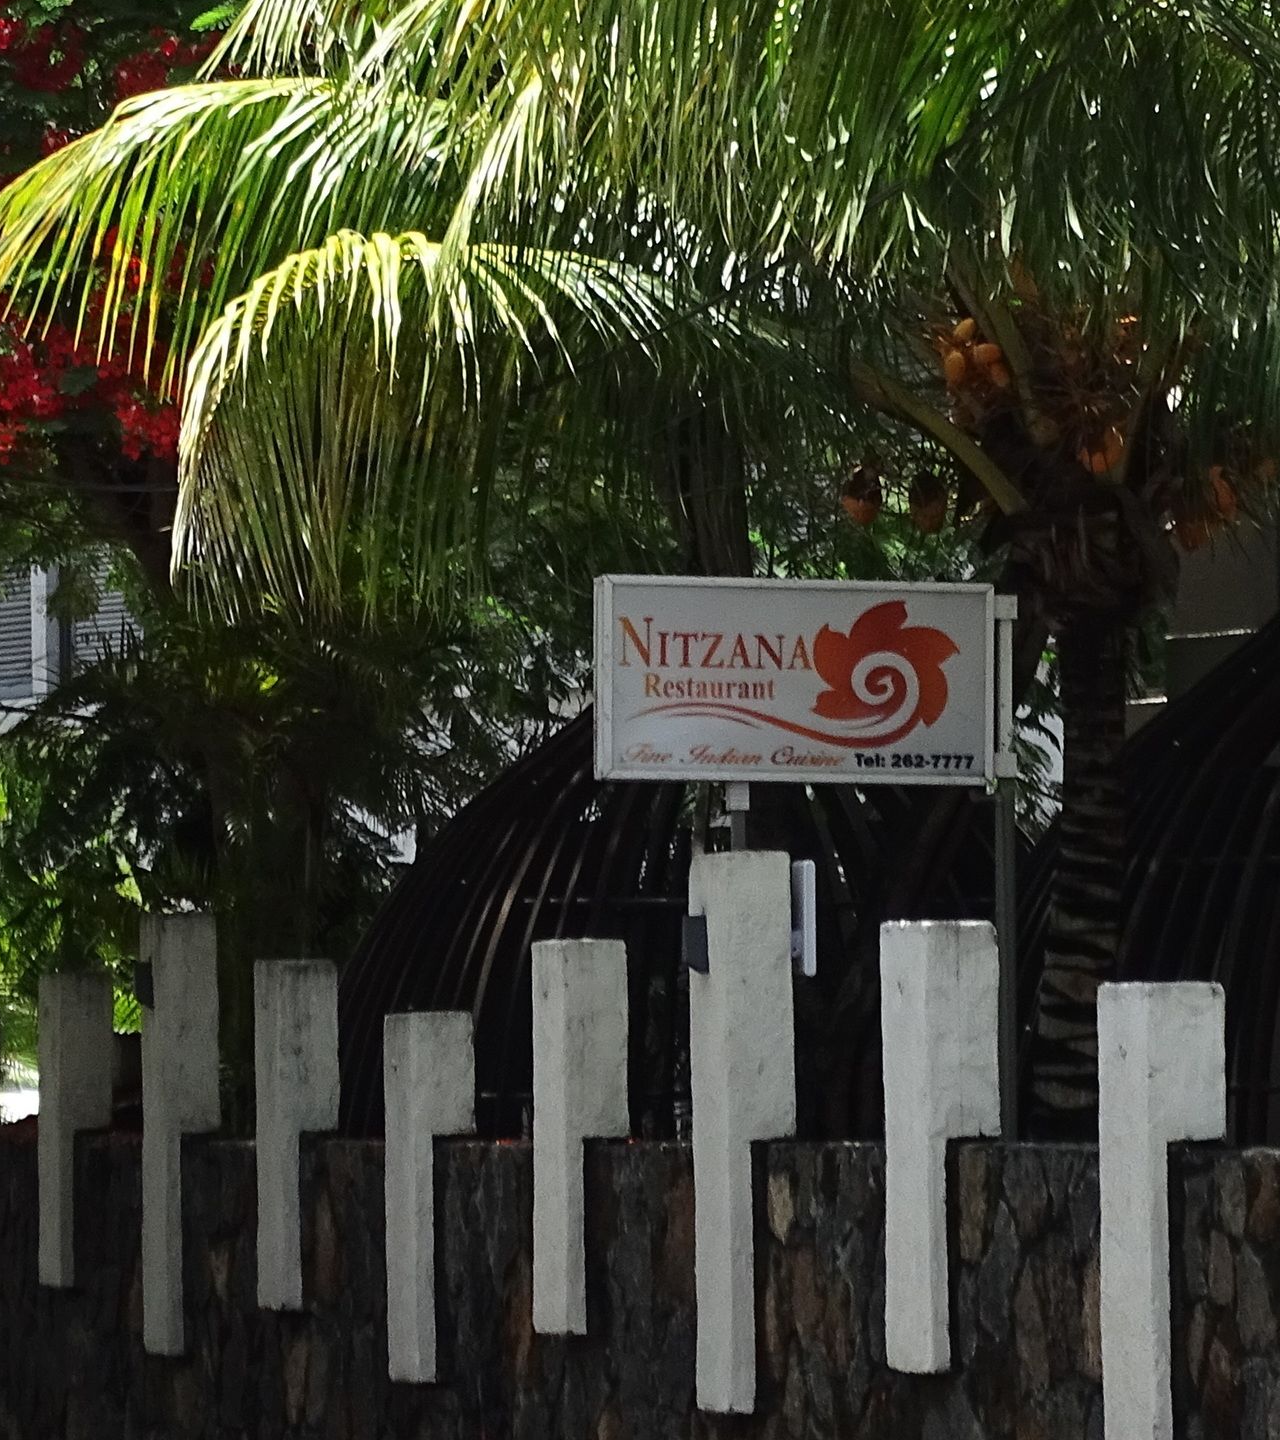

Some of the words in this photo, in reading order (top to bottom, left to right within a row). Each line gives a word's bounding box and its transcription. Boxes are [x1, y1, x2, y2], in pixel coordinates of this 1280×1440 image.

[618, 615, 813, 671] NITZANA
[644, 672, 776, 700] Restaurant
[622, 743, 673, 764] Fine
[682, 744, 763, 766] Indian
[770, 745, 845, 767] Cuisine
[854, 752, 886, 768] Tel:
[890, 753, 975, 770] 262-7777
